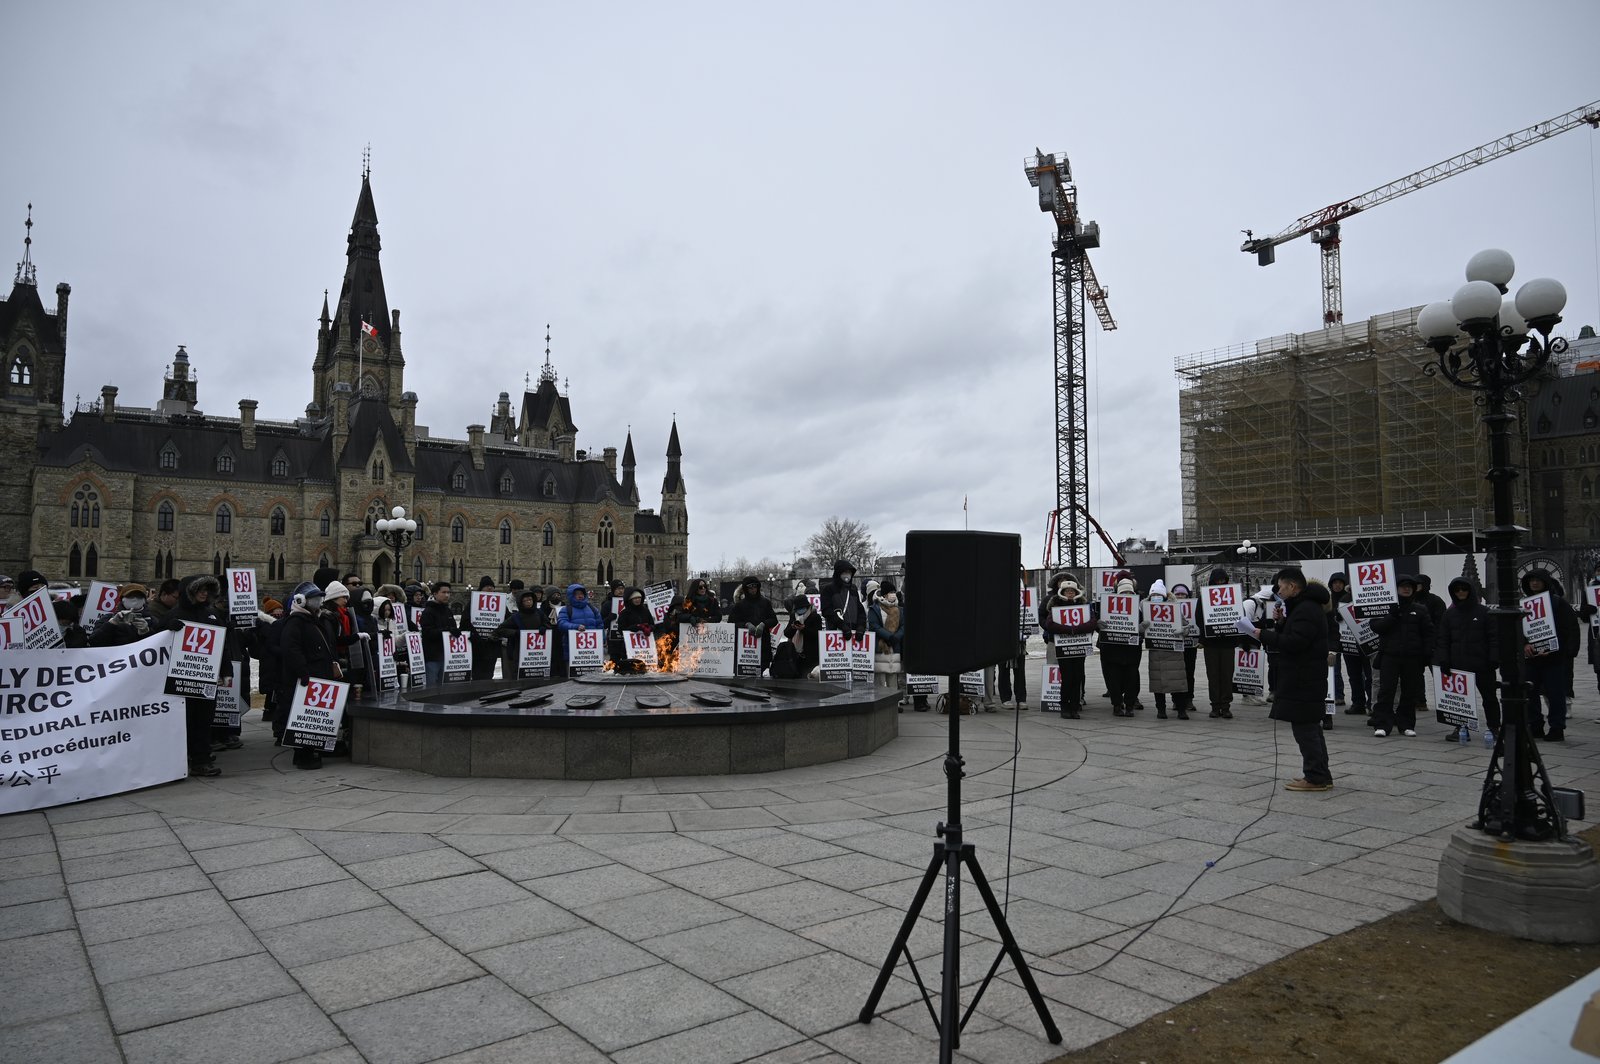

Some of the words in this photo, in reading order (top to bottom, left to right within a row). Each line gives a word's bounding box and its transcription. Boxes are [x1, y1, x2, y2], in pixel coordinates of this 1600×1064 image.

[235, 572, 250, 592] 39
[1361, 564, 1383, 585] 23
[481, 595, 498, 612] 16
[1212, 587, 1233, 606] 34
[1111, 597, 1129, 615] 11
[1153, 604, 1172, 622] 23
[1526, 599, 1542, 621] 37
[1063, 608, 1081, 627] 19
[25, 624, 48, 644] MONTHS
[26, 635, 45, 649] AITING
[43, 627, 55, 640] FOR
[185, 627, 212, 654] 42
[528, 633, 546, 649] 34
[578, 632, 596, 649] 35
[828, 633, 844, 651] 25
[451, 635, 466, 653] 38
[176, 661, 201, 671] WAITING
[183, 654, 209, 663] MONTHS
[1239, 651, 1257, 667] 40
[171, 668, 185, 676] IRCC
[184, 669, 215, 679] RESPONSE
[1444, 674, 1465, 694] 36
[307, 682, 335, 709] 34
[1440, 698, 1460, 707] WAITING
[1444, 694, 1465, 702] MONTHS
[296, 714, 321, 724] WAITING
[304, 708, 329, 718] MONTHS
[1449, 706, 1475, 716] RESPONSE
[2, 714, 86, 741] EDURAL
[90, 701, 170, 725] FAIRNESS
[291, 721, 304, 729] IRCC
[304, 723, 335, 733] RESPONSE
[18, 731, 132, 764] procédurale
[302, 739, 323, 747] RESULTS
